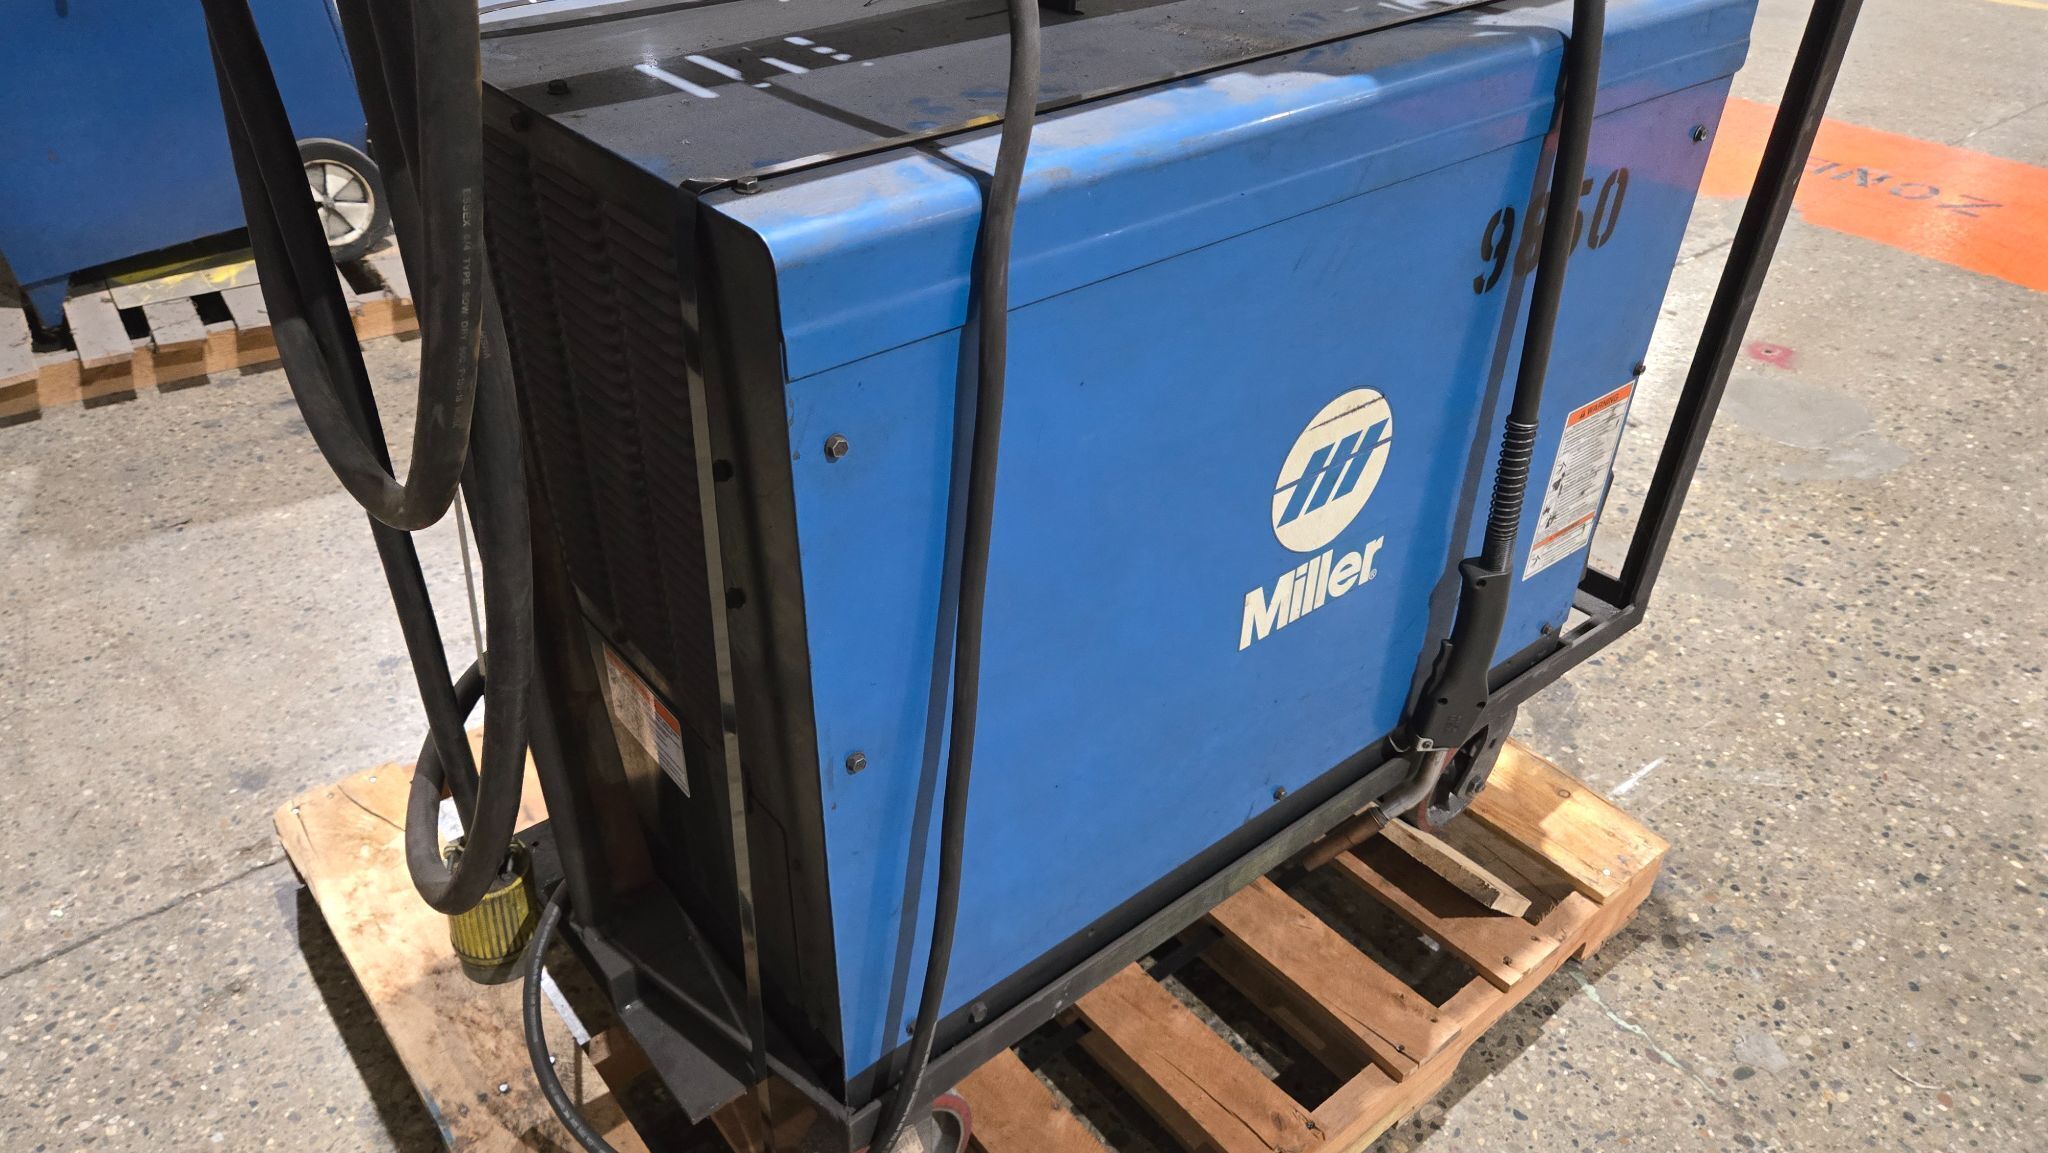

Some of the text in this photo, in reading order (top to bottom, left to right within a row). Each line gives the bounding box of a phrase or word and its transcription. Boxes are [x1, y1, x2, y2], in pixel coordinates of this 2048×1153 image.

[462, 187, 471, 227] ESSEX
[462, 256, 471, 286] TYPE
[1238, 535, 1385, 651] Miller
